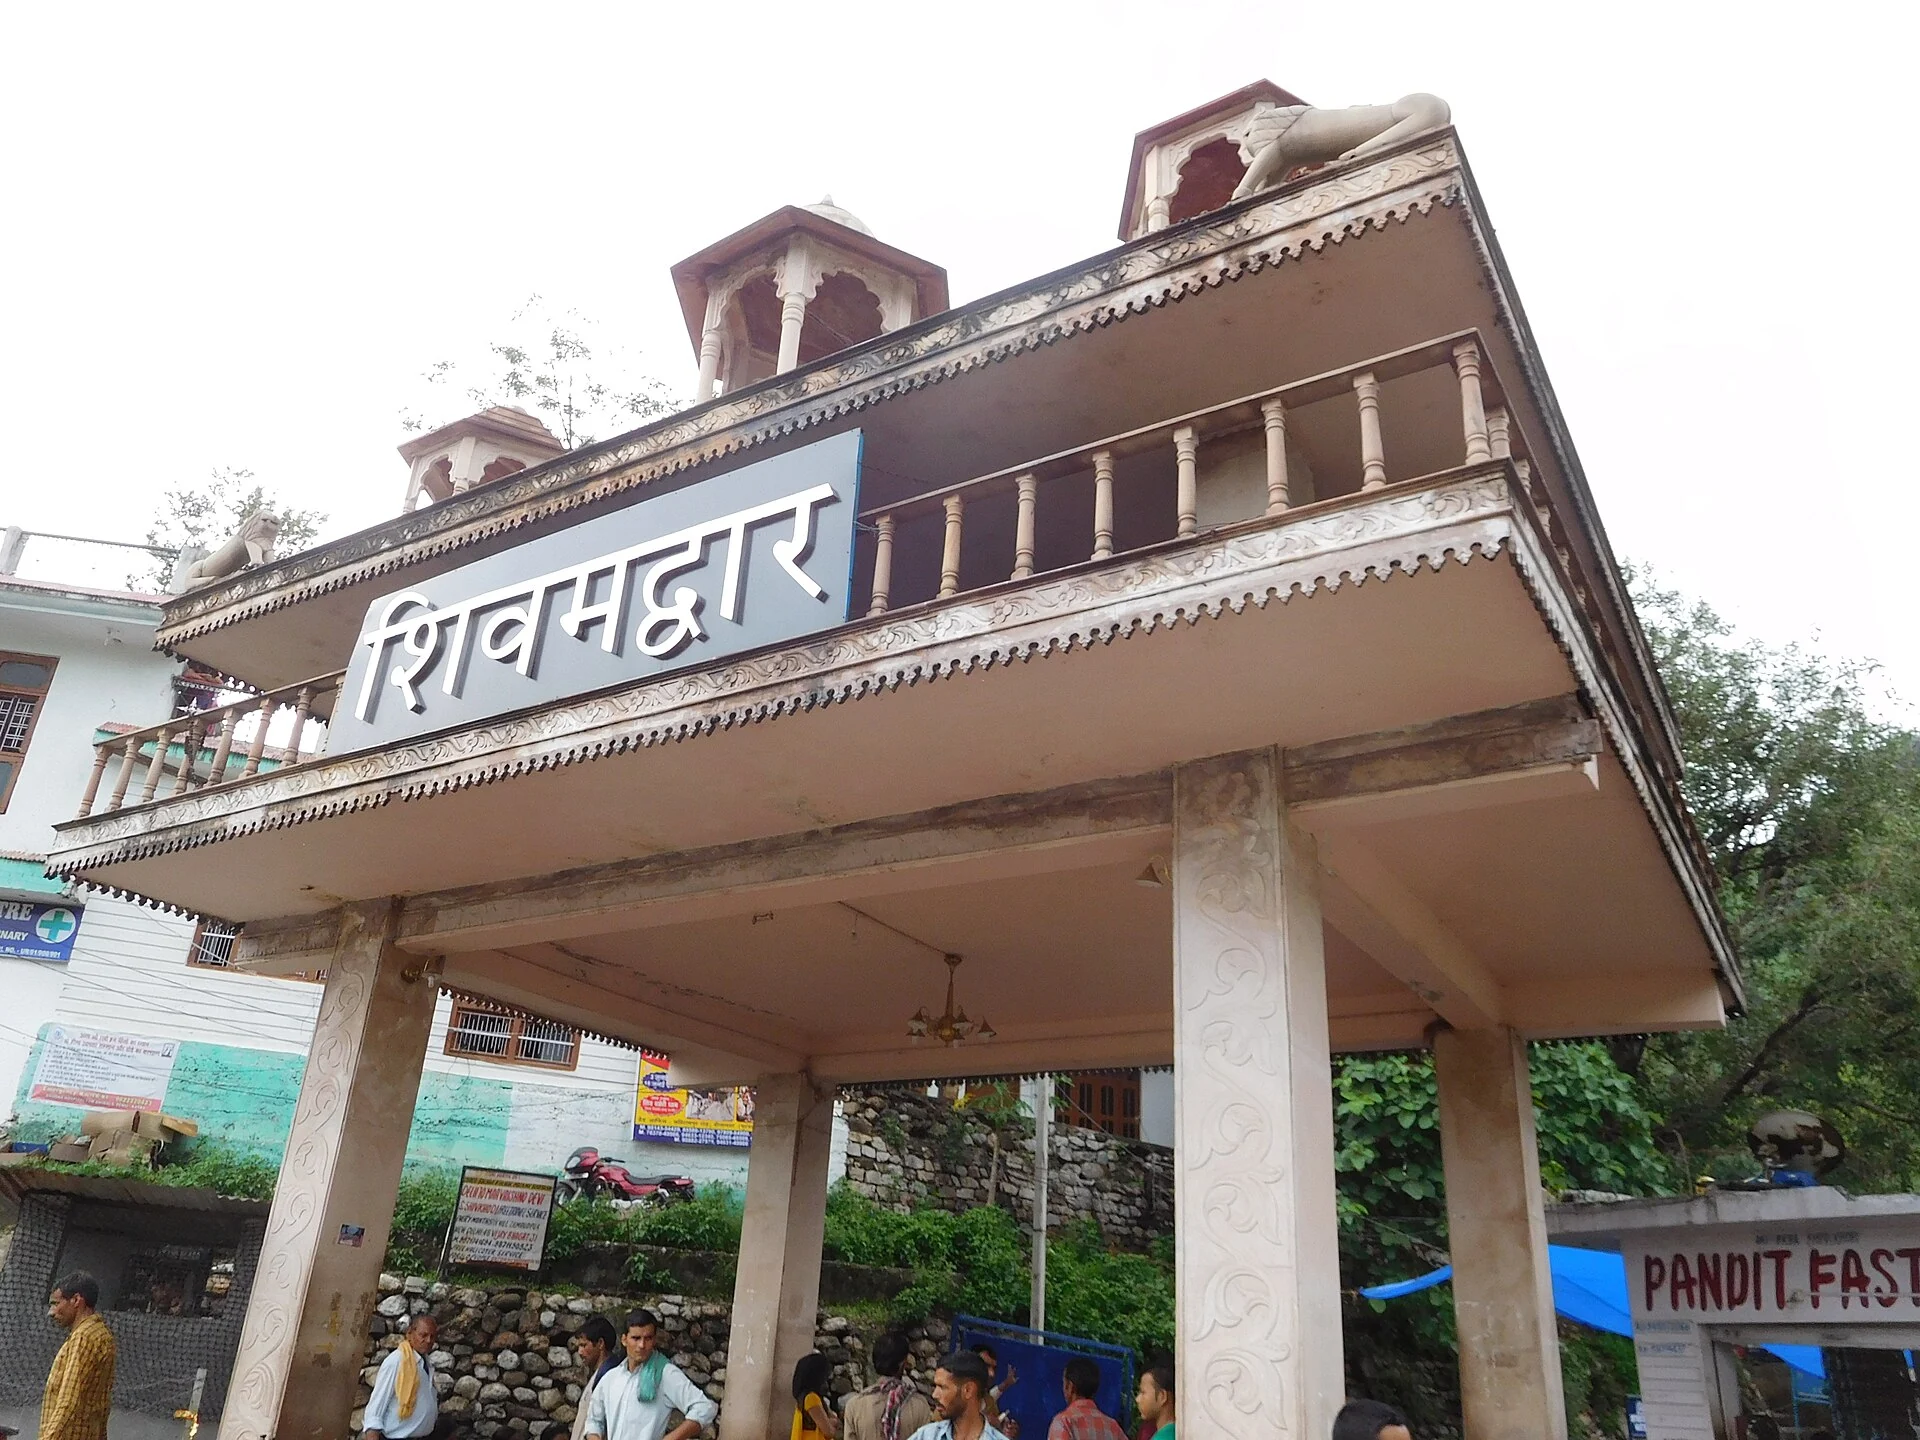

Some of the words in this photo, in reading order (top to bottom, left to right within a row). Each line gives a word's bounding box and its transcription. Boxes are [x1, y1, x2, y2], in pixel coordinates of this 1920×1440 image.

[354, 482, 838, 722] शिवमद्वार
[1644, 1249, 1792, 1311] PANDIT
[1809, 1247, 1920, 1310] FAST
